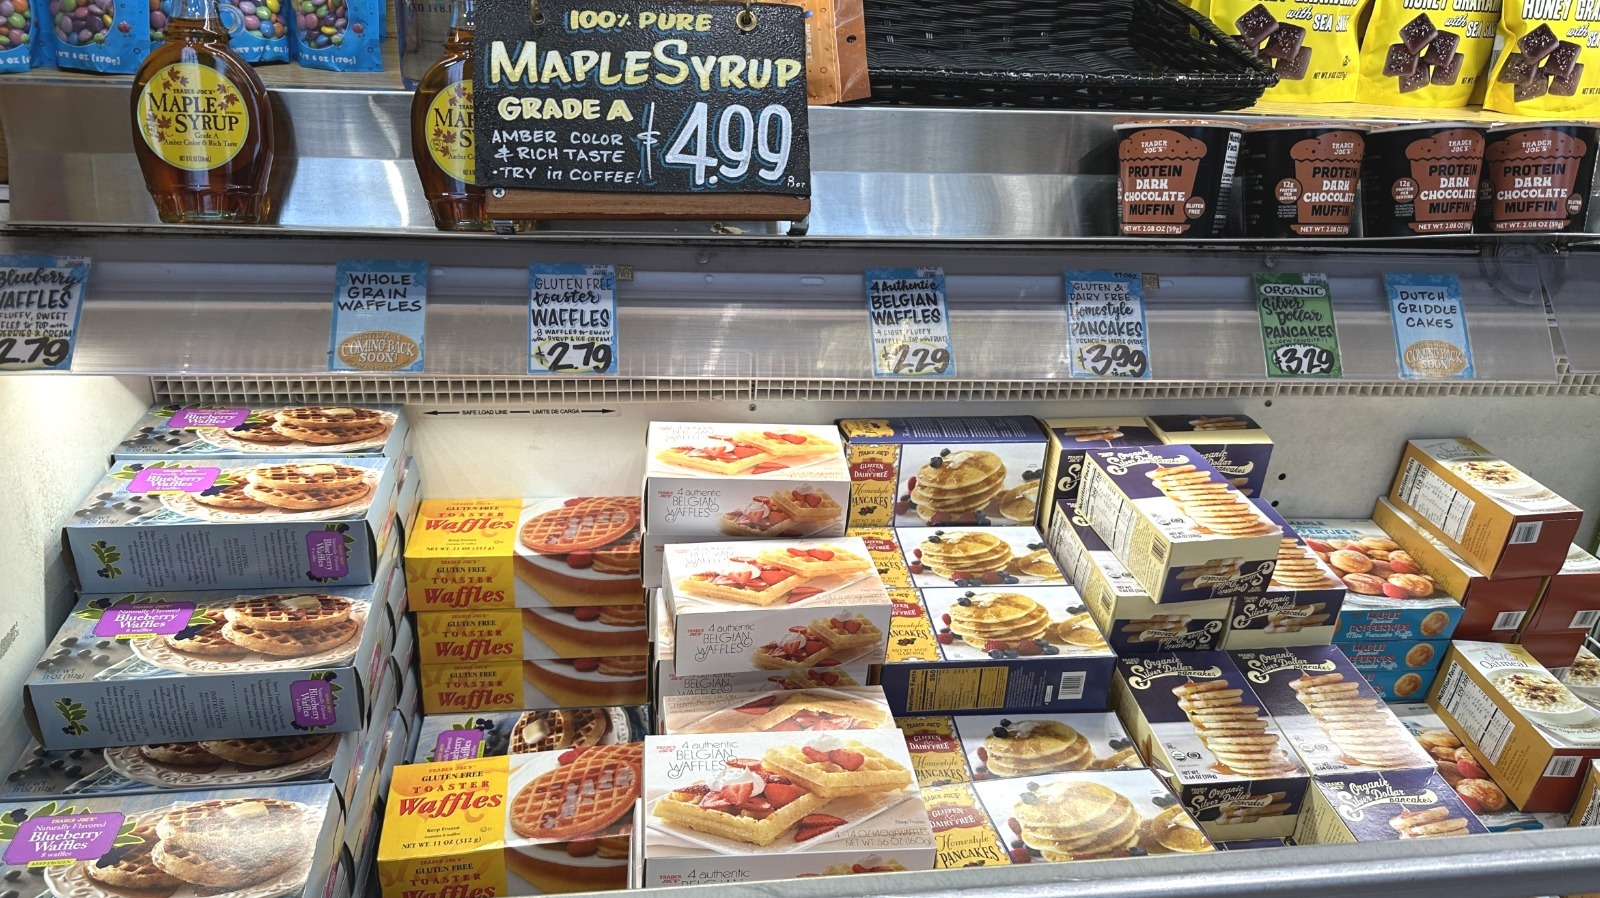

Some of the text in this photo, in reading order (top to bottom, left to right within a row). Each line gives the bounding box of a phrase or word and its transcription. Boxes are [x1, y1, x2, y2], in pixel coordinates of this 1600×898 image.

[1286, 6, 1313, 21] with
[570, 10, 714, 32] 100% PURE
[1313, 13, 1333, 31] SEA
[1444, 14, 1467, 28] with
[1566, 27, 1588, 39] with
[491, 39, 802, 91] MAPLE SYRUP
[147, 92, 217, 114] MAPLE
[497, 97, 634, 122] GRADE A
[175, 113, 240, 133] SYRUP
[491, 130, 624, 146] AMBER COLOR
[1141, 140, 1168, 148] TRADER
[1448, 140, 1473, 148] TRADER
[1521, 139, 1552, 148] TRADER
[518, 148, 626, 163] RICH TASTE
[1128, 165, 1183, 177] PROTEIN
[1311, 166, 1357, 179] PROTEIN
[1428, 164, 1478, 177] PROTEIN
[1503, 163, 1566, 177] PROTEIN
[569, 169, 641, 185] COFFEE!
[1439, 177, 1470, 189] DARK
[1514, 176, 1552, 188] DARK
[1136, 179, 1169, 190] DARK
[1322, 180, 1350, 191] DARK
[1124, 191, 1186, 202] CHOCOLATE
[1303, 193, 1355, 203] CHOCOLATE
[1420, 190, 1476, 201] CHOCOLATE
[1496, 188, 1568, 200] CHOCOLATE
[1129, 203, 1175, 216] MUFFIN
[1310, 203, 1350, 217] MUFFIN
[1428, 202, 1471, 215] MUFFIN
[1504, 201, 1558, 214] MUFFIN
[1549, 221, 1564, 230] (59g)
[349, 272, 412, 286] WHOLE
[534, 277, 613, 291] GLUTEN FREE
[347, 286, 408, 300] GRAIN
[881, 279, 940, 294] Authentic
[1073, 283, 1111, 291] GLUTEN
[1263, 285, 1324, 296] ORGANIC
[532, 289, 600, 307] toaster
[871, 292, 939, 310] BELGIAN
[1070, 292, 1132, 302] DAIRY FREE
[1400, 290, 1446, 302] DUTCH
[338, 299, 422, 312] WAFFLES
[1397, 302, 1458, 315] GRIDDLE
[36, 311, 69, 320] SWEET
[531, 308, 611, 328] WAFFLES
[871, 308, 942, 326] WAFFLES
[36, 321, 49, 330] TOP
[1070, 320, 1143, 337] PANCAKES
[1405, 316, 1454, 329] CAKES
[1263, 325, 1334, 339] PANCAKES
[341, 339, 415, 358] COMING BACK
[358, 352, 399, 363] SOON!
[880, 343, 951, 374] $2.29
[1077, 344, 1147, 378] $3.99
[1436, 450, 1480, 460] Oatmeal
[148, 475, 204, 484] Blueberry
[685, 488, 721, 497] authentic
[672, 496, 720, 512] BELGIAN
[664, 508, 711, 523] WAFFLES
[424, 517, 516, 534] Waffles
[436, 566, 467, 574] GLUTEN
[431, 576, 494, 585] TOASTER
[423, 586, 505, 609] Waffles
[114, 613, 178, 623] Blueberry
[149, 608, 181, 616] Flavored
[1367, 612, 1401, 620] MAPLE
[119, 620, 166, 629] Waffles
[716, 623, 755, 632] authentic
[441, 629, 503, 638] TOASTER
[703, 631, 753, 647] BELGIAN
[1365, 631, 1393, 640] Pancake
[434, 638, 514, 661] Waffles
[694, 645, 744, 661] WAFFLES
[1352, 643, 1387, 652] MAPLE
[1144, 656, 1181, 669] Organic
[1259, 652, 1296, 664] Organic
[1278, 657, 1308, 668] Dollar
[1163, 665, 1194, 674] Dollar
[1479, 660, 1529, 671] Oatmeal
[449, 671, 479, 679] GLUTEN
[444, 681, 504, 689] TOASTER
[437, 689, 515, 711] Waffles
[691, 740, 739, 748] authentic
[909, 741, 950, 750] DAIRY FREE
[913, 735, 942, 743] GLUTEN
[676, 748, 739, 764] BELGIAN
[421, 770, 484, 782] GLUTEN FREE
[667, 761, 728, 779] WAFFLES
[412, 780, 490, 794] TOASTER
[1208, 785, 1245, 798] Organic
[1349, 778, 1391, 793] Organic
[1371, 787, 1406, 801] Dollar
[399, 790, 504, 819] Waffles
[1229, 799, 1265, 808] pancakes
[1389, 797, 1433, 805] pancakes
[931, 807, 965, 818] GLUTEN
[35, 821, 106, 832] Naturally Flavored
[929, 814, 976, 829] DAIRY FREE
[28, 830, 103, 842] Blueberry
[845, 838, 860, 847] NET
[934, 831, 990, 852] Homestyle
[35, 840, 89, 853] Waffles
[939, 845, 1000, 868] PANCAKES
[415, 863, 474, 874] GLUTEN FREE
[687, 868, 752, 880] 4 authentic
[409, 873, 482, 887] TOASTER
